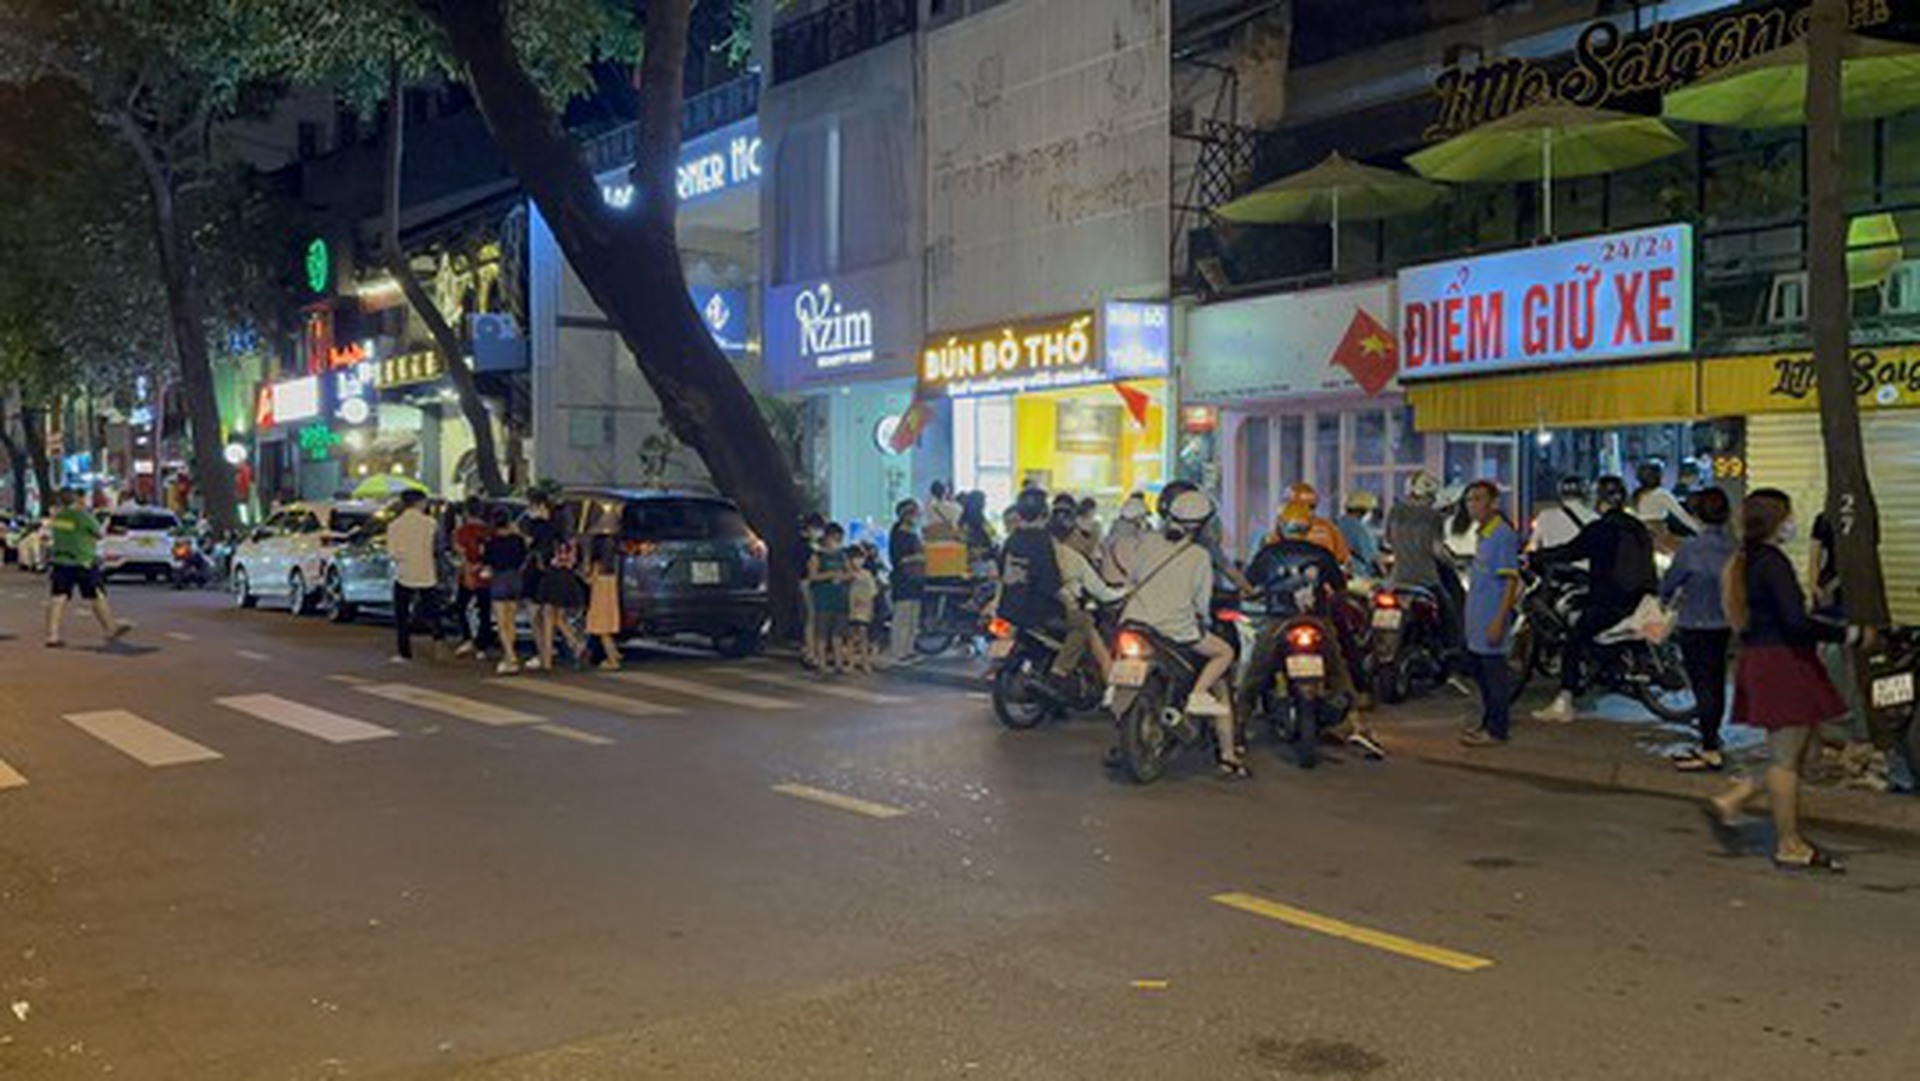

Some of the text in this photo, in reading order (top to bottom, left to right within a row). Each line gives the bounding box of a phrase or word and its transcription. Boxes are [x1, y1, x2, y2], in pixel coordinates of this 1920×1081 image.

[1557, 7, 1787, 109] Saigon
[1602, 233, 1674, 262] 24/24
[923, 335, 976, 380] BÚN
[980, 329, 1019, 373] BÒ
[1024, 315, 1092, 368] THỐ
[1403, 263, 1675, 368] ĐIỂM GIỮ XE
